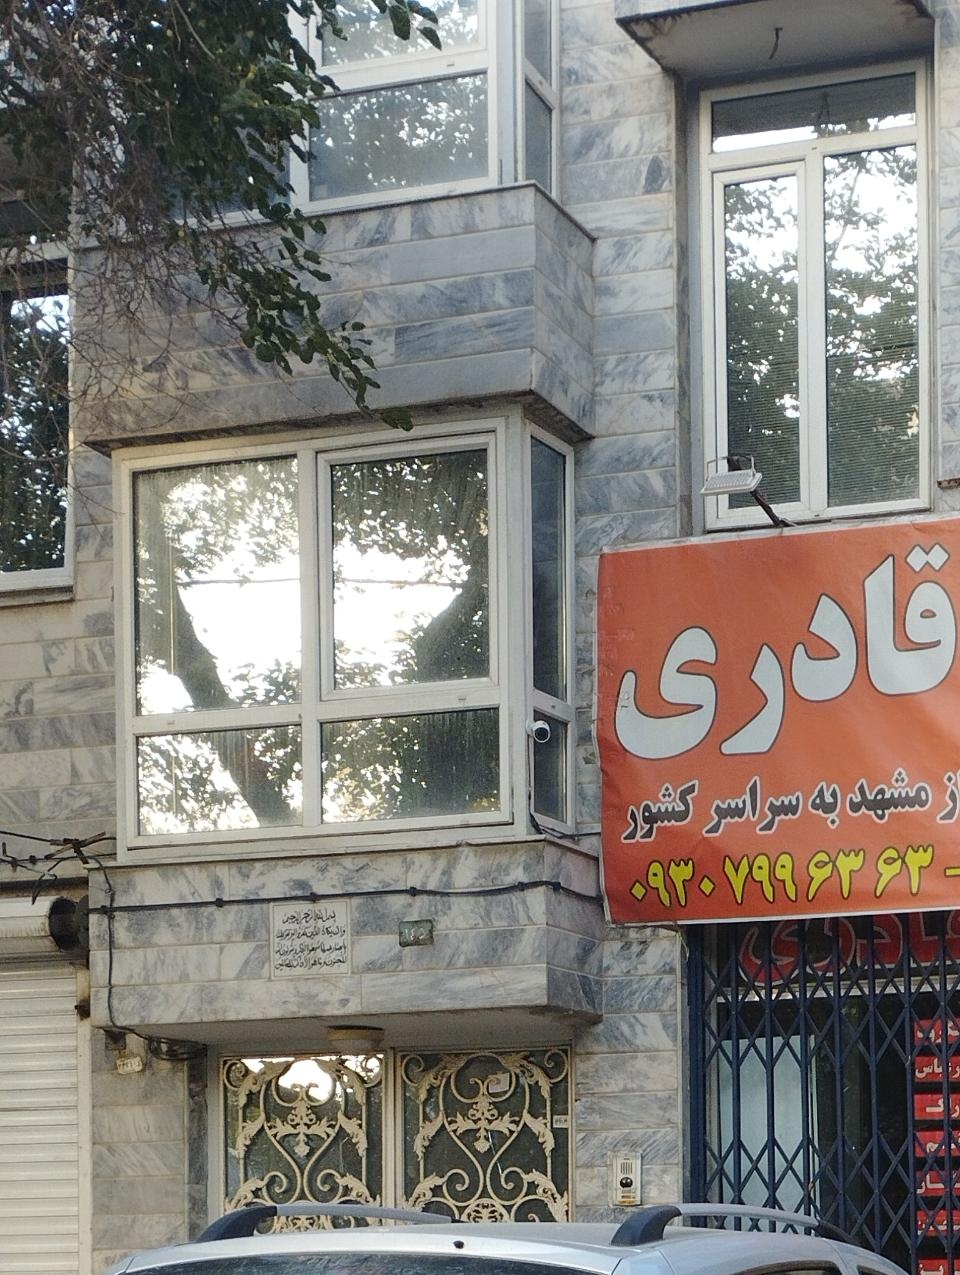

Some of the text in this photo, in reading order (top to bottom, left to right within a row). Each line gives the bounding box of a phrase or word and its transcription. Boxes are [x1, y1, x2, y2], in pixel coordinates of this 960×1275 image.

[614, 543, 958, 760] قادری
[621, 780, 699, 842] کشور
[702, 776, 803, 837] سراسر
[809, 781, 840, 829] به
[847, 768, 932, 822] مشهد
